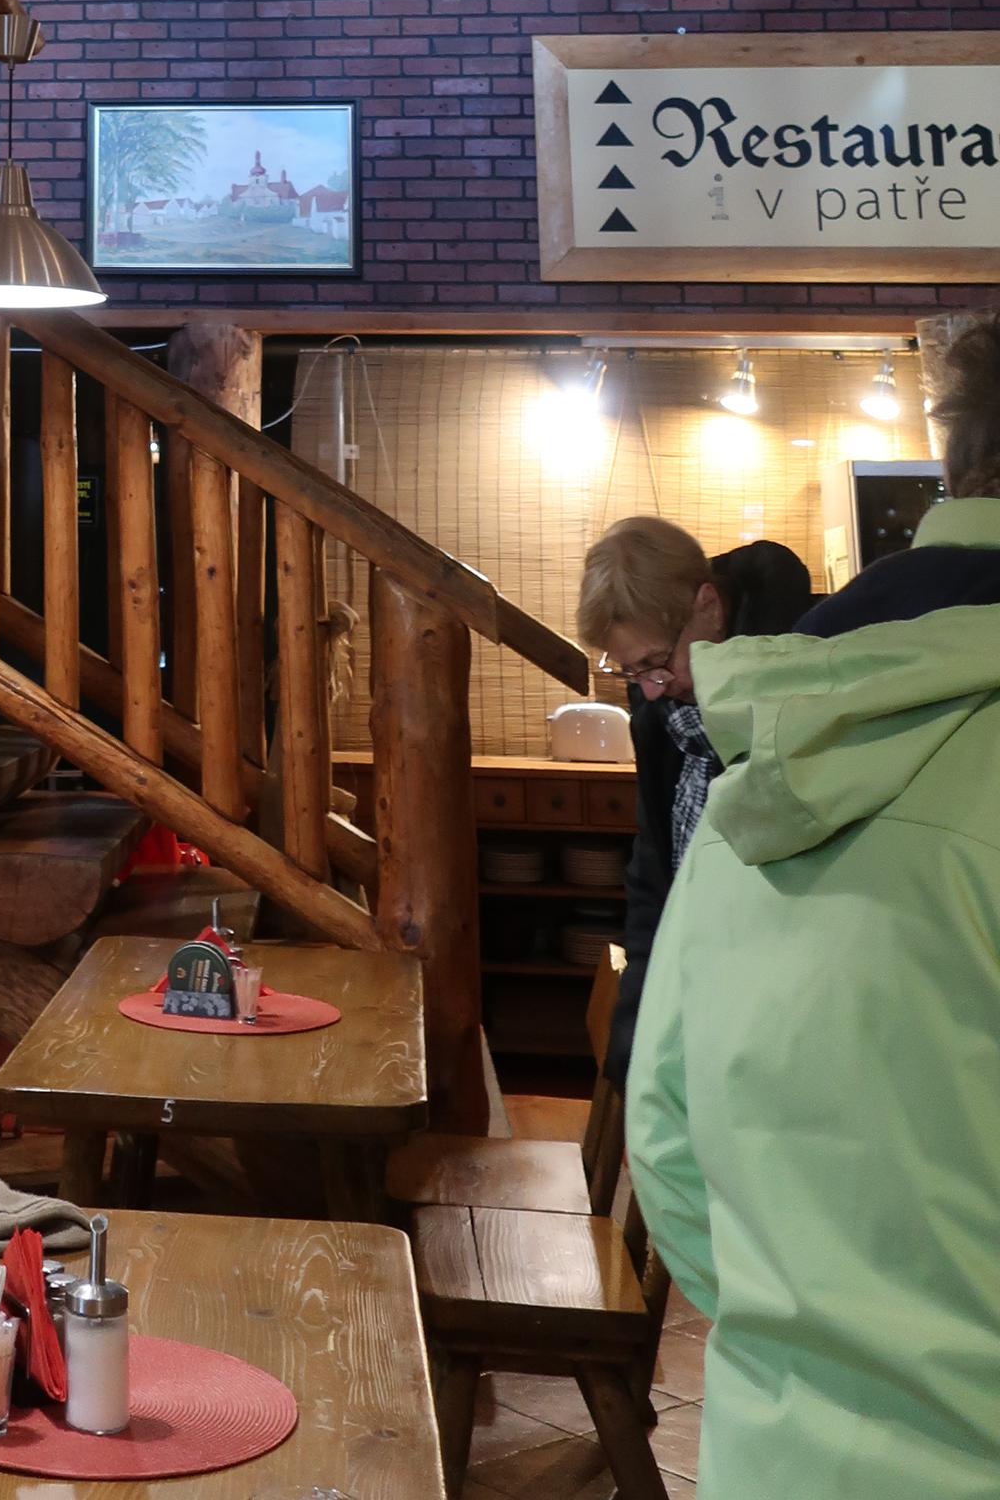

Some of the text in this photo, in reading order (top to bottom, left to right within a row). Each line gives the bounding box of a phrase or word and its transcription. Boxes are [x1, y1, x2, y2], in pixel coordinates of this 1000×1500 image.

[652, 97, 1000, 169] Restaura
[755, 188, 784, 220] v
[815, 175, 968, 232] patře
